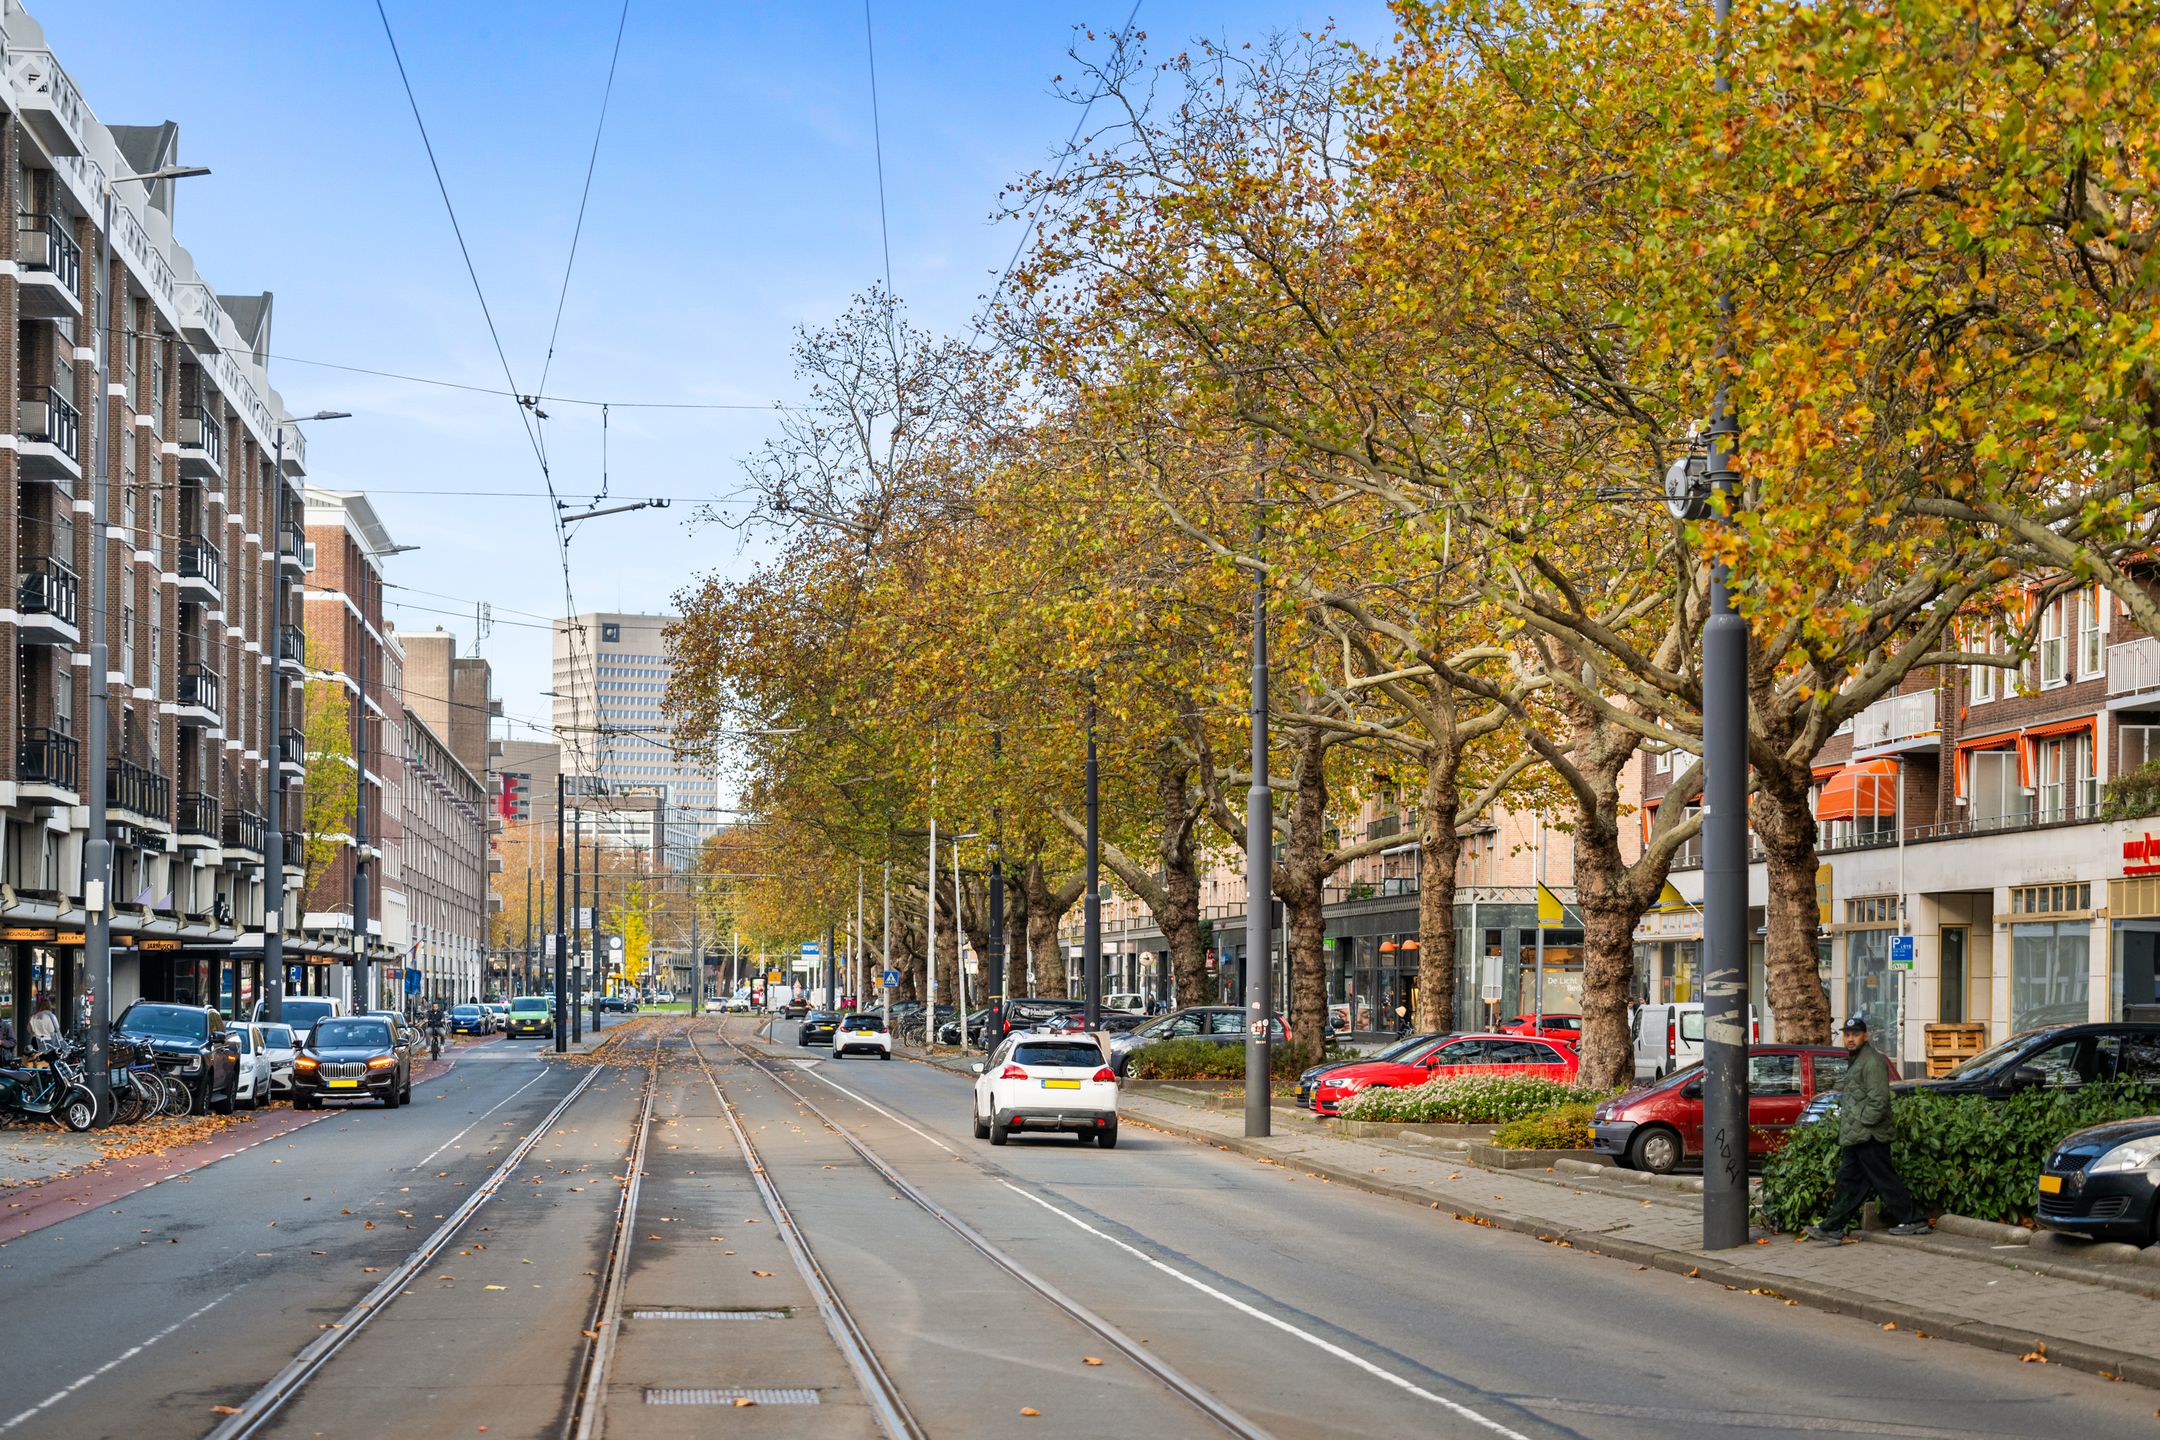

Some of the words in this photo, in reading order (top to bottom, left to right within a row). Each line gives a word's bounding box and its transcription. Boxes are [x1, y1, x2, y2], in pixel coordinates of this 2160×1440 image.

[1892, 938, 1901, 949] P
[290, 966, 296, 974] P
[1548, 977, 1557, 985] De
